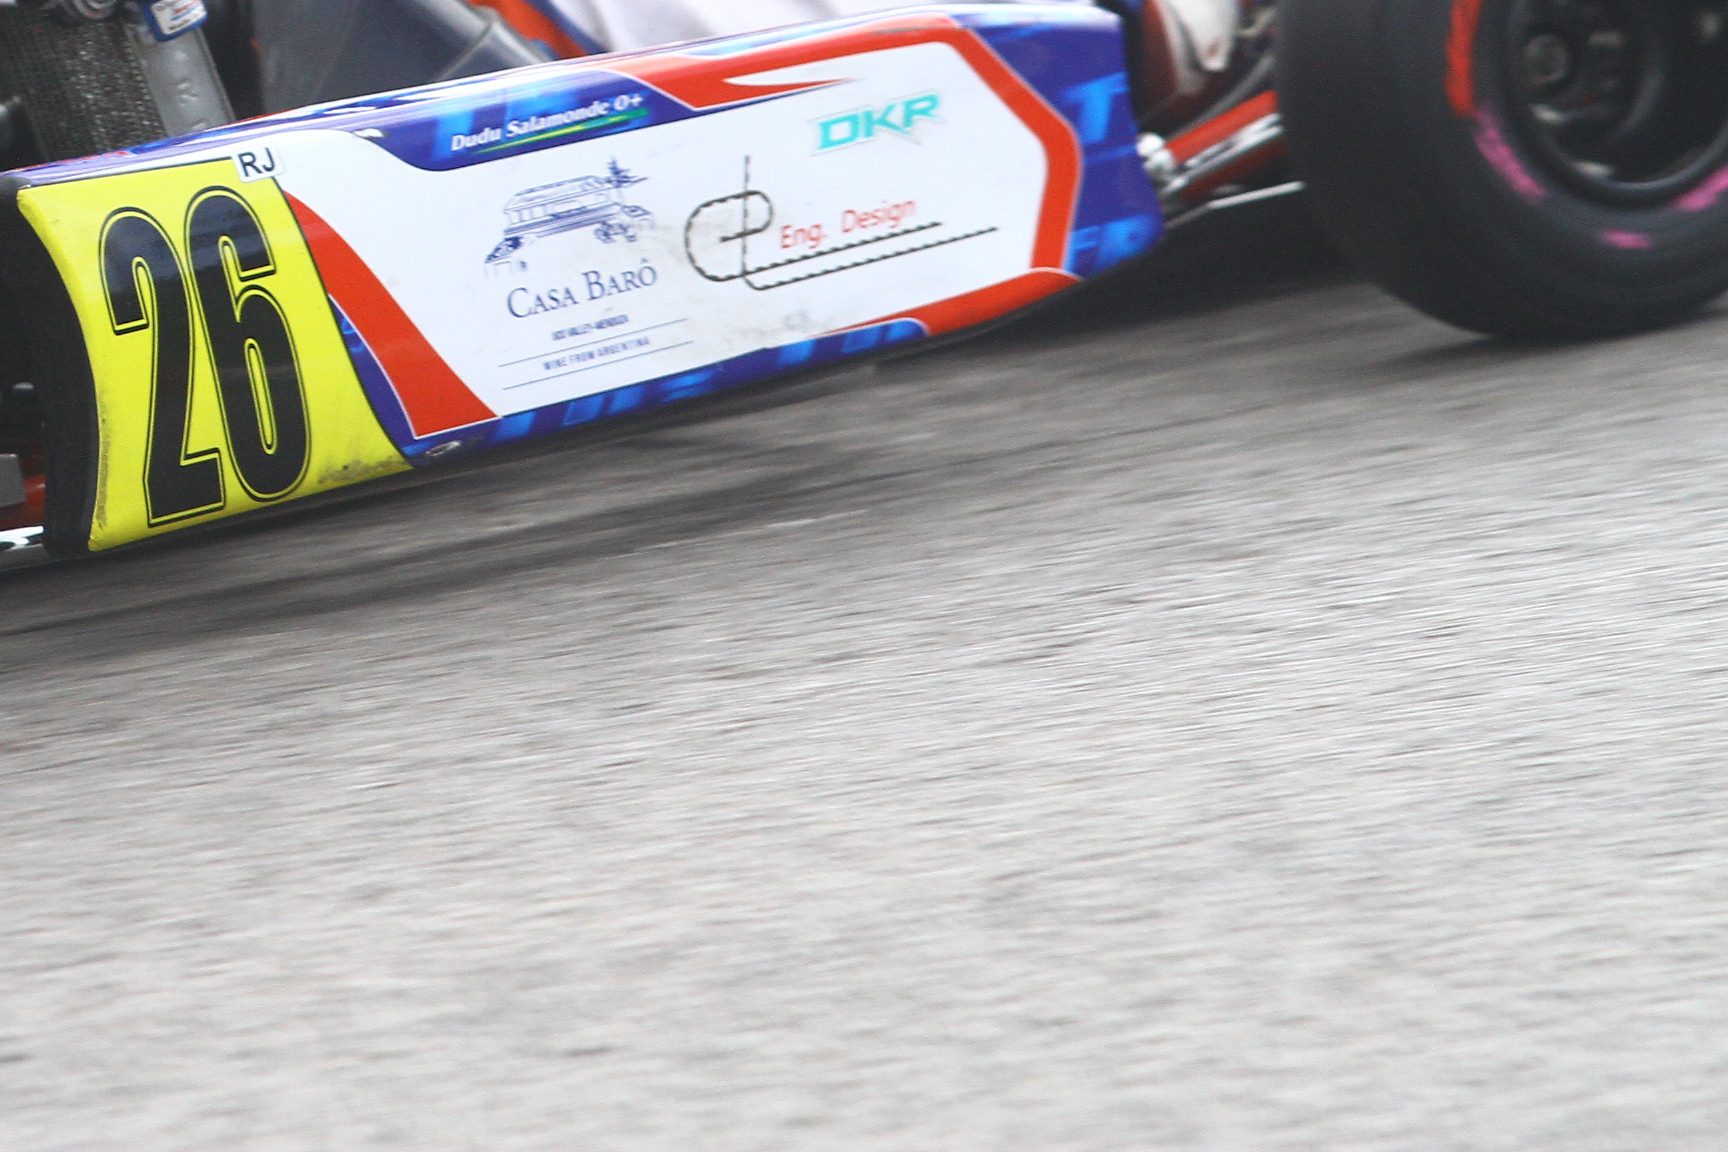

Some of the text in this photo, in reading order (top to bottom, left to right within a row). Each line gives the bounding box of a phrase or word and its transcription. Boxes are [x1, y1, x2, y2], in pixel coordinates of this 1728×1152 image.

[450, 127, 502, 151] Dudu
[505, 100, 609, 138] Salamonde
[817, 94, 939, 151] DKR
[237, 147, 275, 177] RJ
[780, 200, 917, 249] Eng. Design
[99, 185, 312, 528] 26
